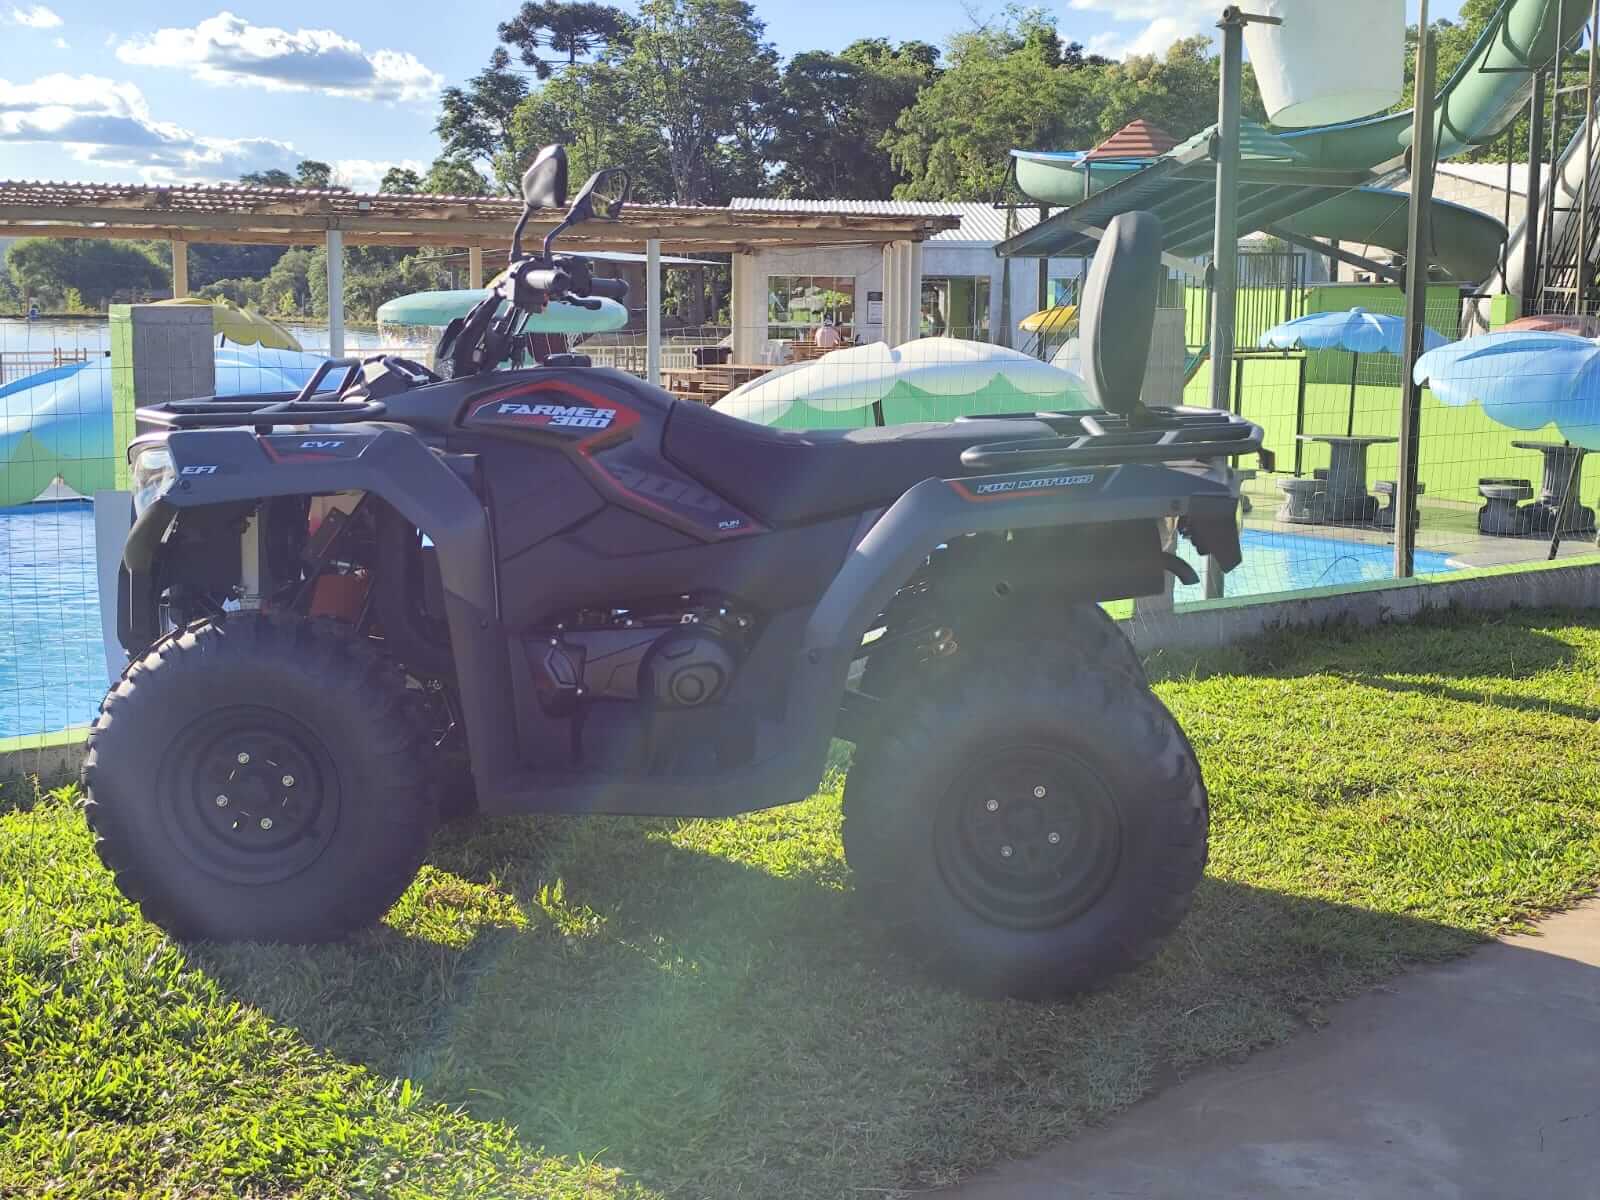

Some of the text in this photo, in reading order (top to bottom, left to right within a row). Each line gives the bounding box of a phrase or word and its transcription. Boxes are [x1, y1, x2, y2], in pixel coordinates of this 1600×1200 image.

[497, 404, 616, 418] FARMER
[548, 416, 610, 428] 300
[181, 465, 217, 474] EFI
